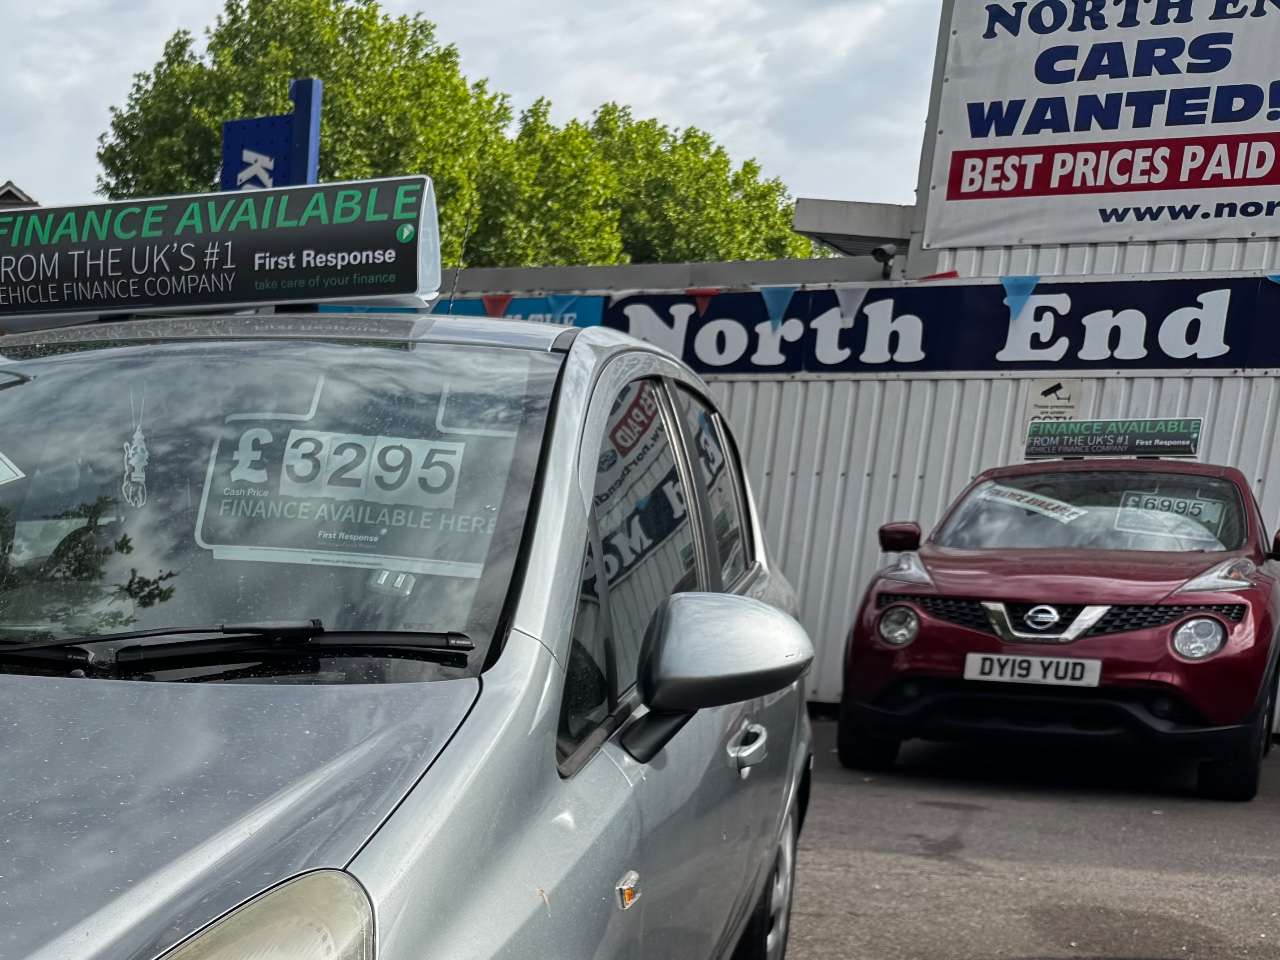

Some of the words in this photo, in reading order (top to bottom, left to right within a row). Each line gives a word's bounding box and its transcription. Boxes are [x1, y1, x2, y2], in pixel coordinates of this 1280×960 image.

[982, 0, 1194, 39] NORTH
[1035, 32, 1234, 85] CARS
[967, 80, 1280, 138] WANTED!
[960, 154, 1043, 194] BEST
[1050, 147, 1170, 188] PRICES
[1180, 141, 1276, 182] PAID
[174, 184, 421, 235] AVAILABLE
[71, 248, 122, 280] THE
[132, 243, 196, 275] UK'S
[203, 240, 236, 270] #1
[254, 252, 296, 272] First
[303, 248, 396, 270] Response
[63, 277, 140, 300] FINANCE
[145, 273, 236, 296] COMPANY
[255, 280, 278, 290] take
[281, 279, 305, 289] care
[308, 276, 320, 287] of
[323, 275, 349, 288] your
[353, 273, 397, 285] finance
[623, 298, 925, 366] North
[996, 289, 1231, 362] End
[1028, 436, 1060, 446] FROM
[1063, 436, 1084, 446] THE
[1087, 435, 1114, 445] UK'S
[1029, 423, 1104, 436] FINANCE
[1106, 421, 1200, 434] AVAILABLE
[223, 487, 245, 497] Cash
[247, 487, 270, 497] Price
[219, 499, 309, 521] FINANCE
[314, 501, 433, 530] AVAILABLE
[318, 530, 337, 539] First
[338, 532, 379, 543] Response
[979, 656, 1031, 679] DY19
[1040, 658, 1086, 681] YUD
